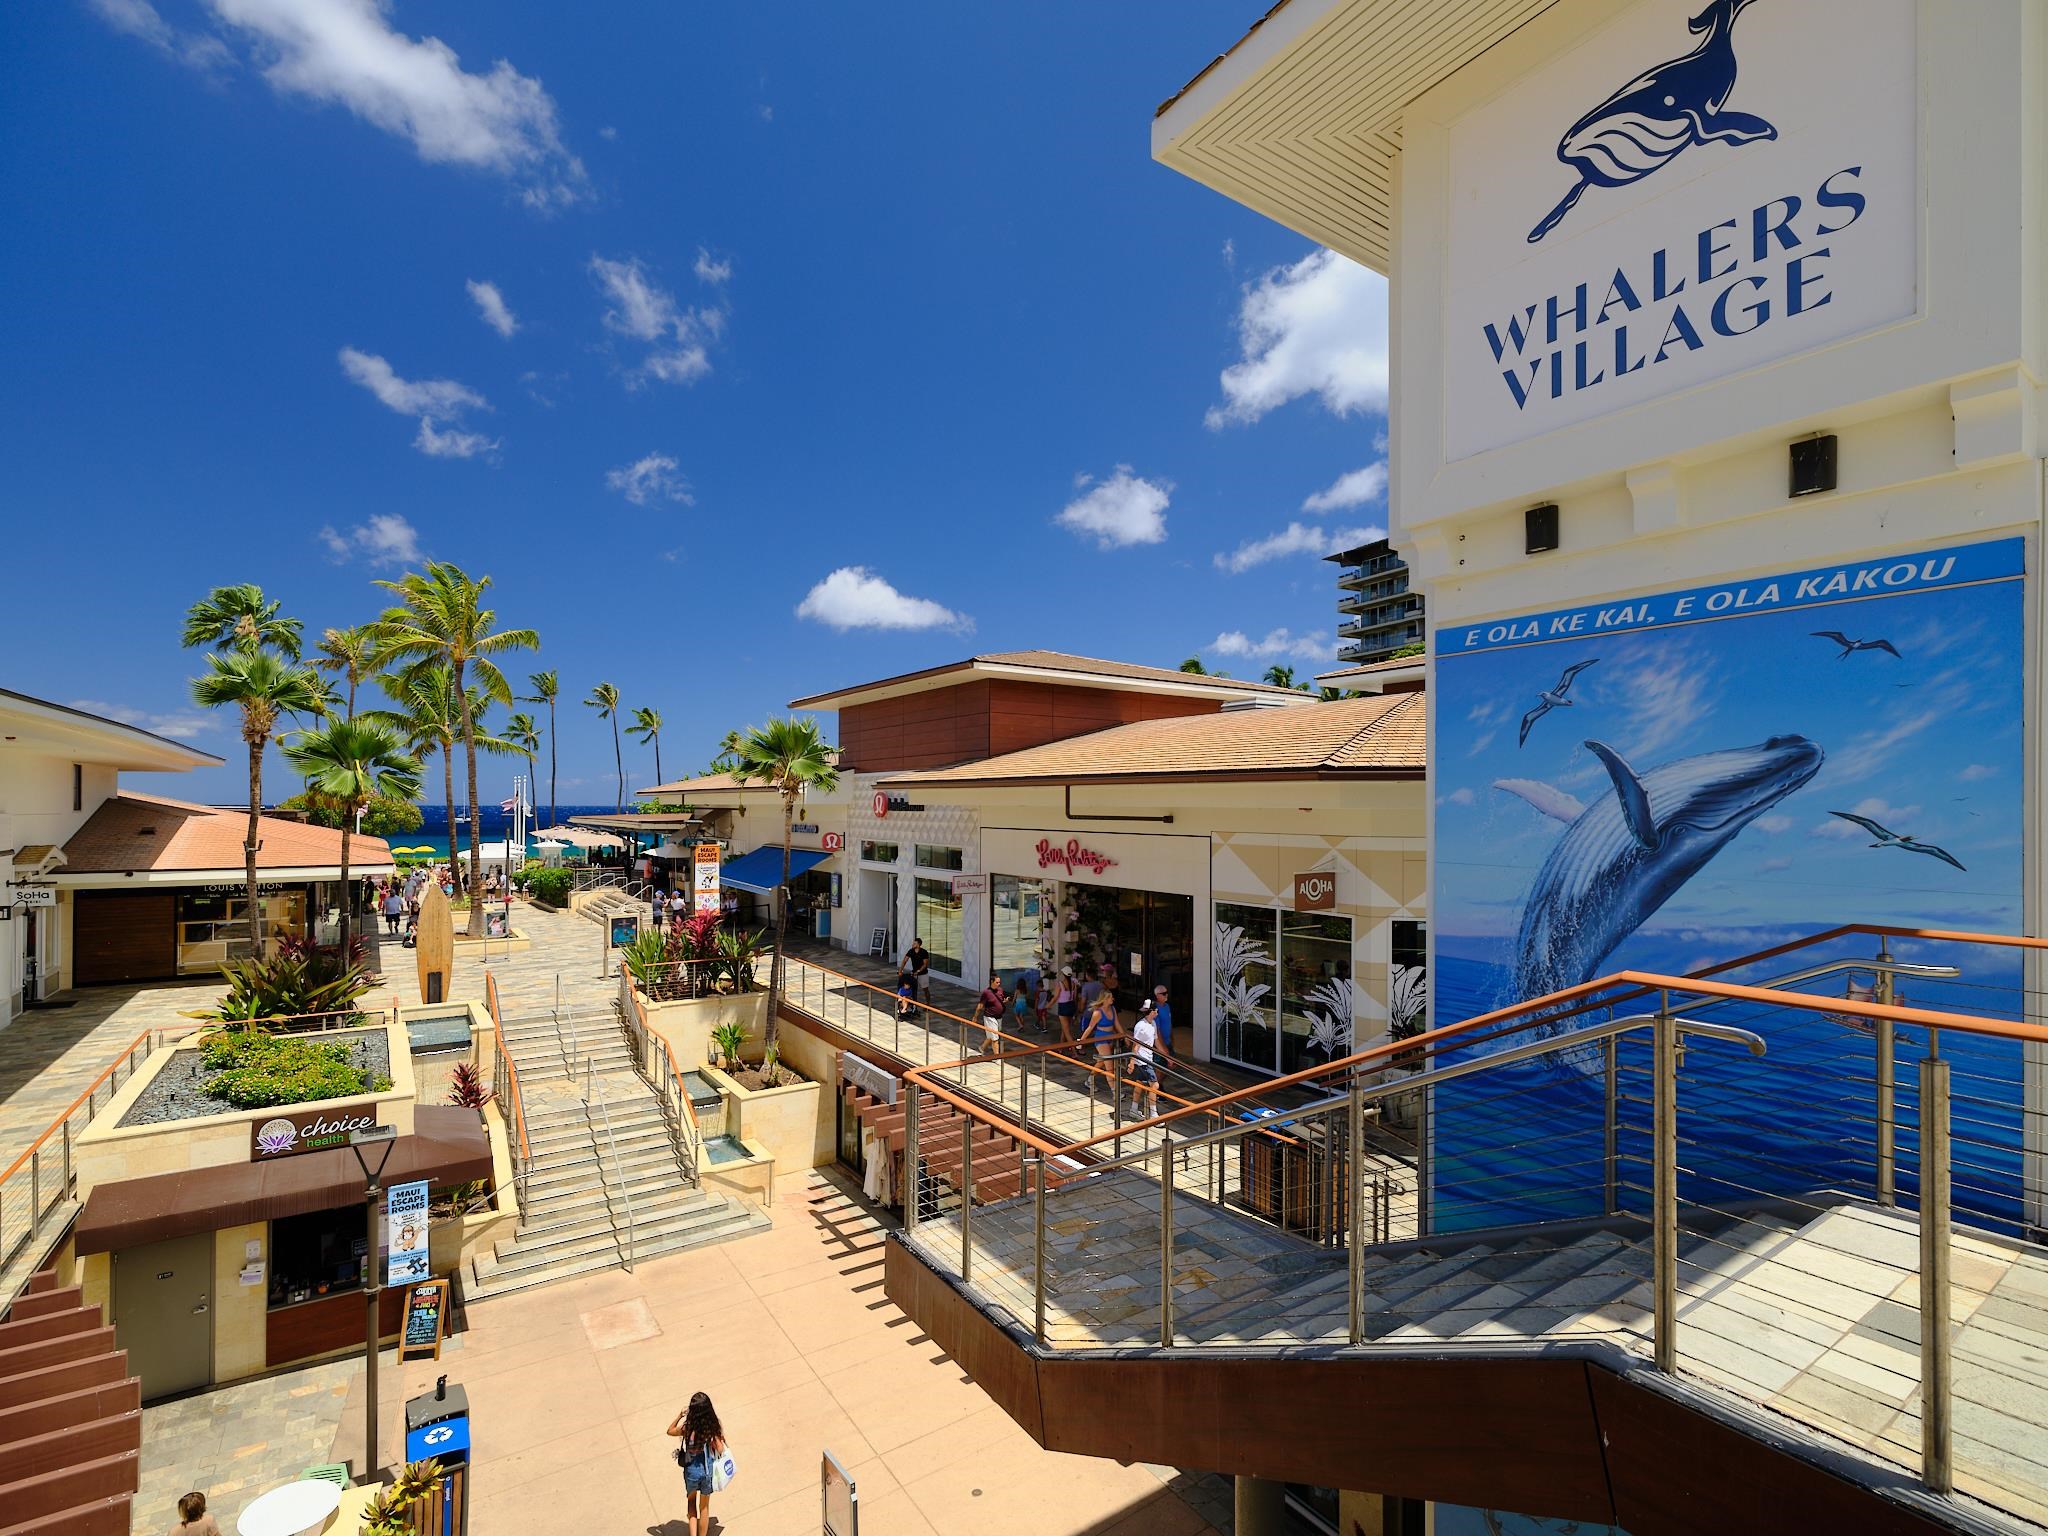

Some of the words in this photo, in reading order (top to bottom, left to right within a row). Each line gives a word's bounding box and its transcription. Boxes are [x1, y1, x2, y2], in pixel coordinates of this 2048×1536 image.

[1483, 166, 1866, 365] WHALERS
[1502, 248, 1833, 411] VILLAGE
[1464, 629, 1482, 647] E
[1487, 620, 1540, 643] OLA
[1549, 612, 1587, 634] KE
[1595, 606, 1656, 628] KAI,
[1673, 596, 1696, 617] E
[1705, 583, 1780, 611] OLA
[1795, 556, 1957, 599] KĀKOU
[204, 883, 235, 892] LOUIS
[1300, 878, 1333, 901] ALOHA
[300, 1114, 375, 1138] choice
[306, 1133, 345, 1148] health
[391, 1194, 426, 1207] ESCAPE
[396, 1188, 421, 1199] MAUI
[391, 1202, 425, 1215] ROOMS
